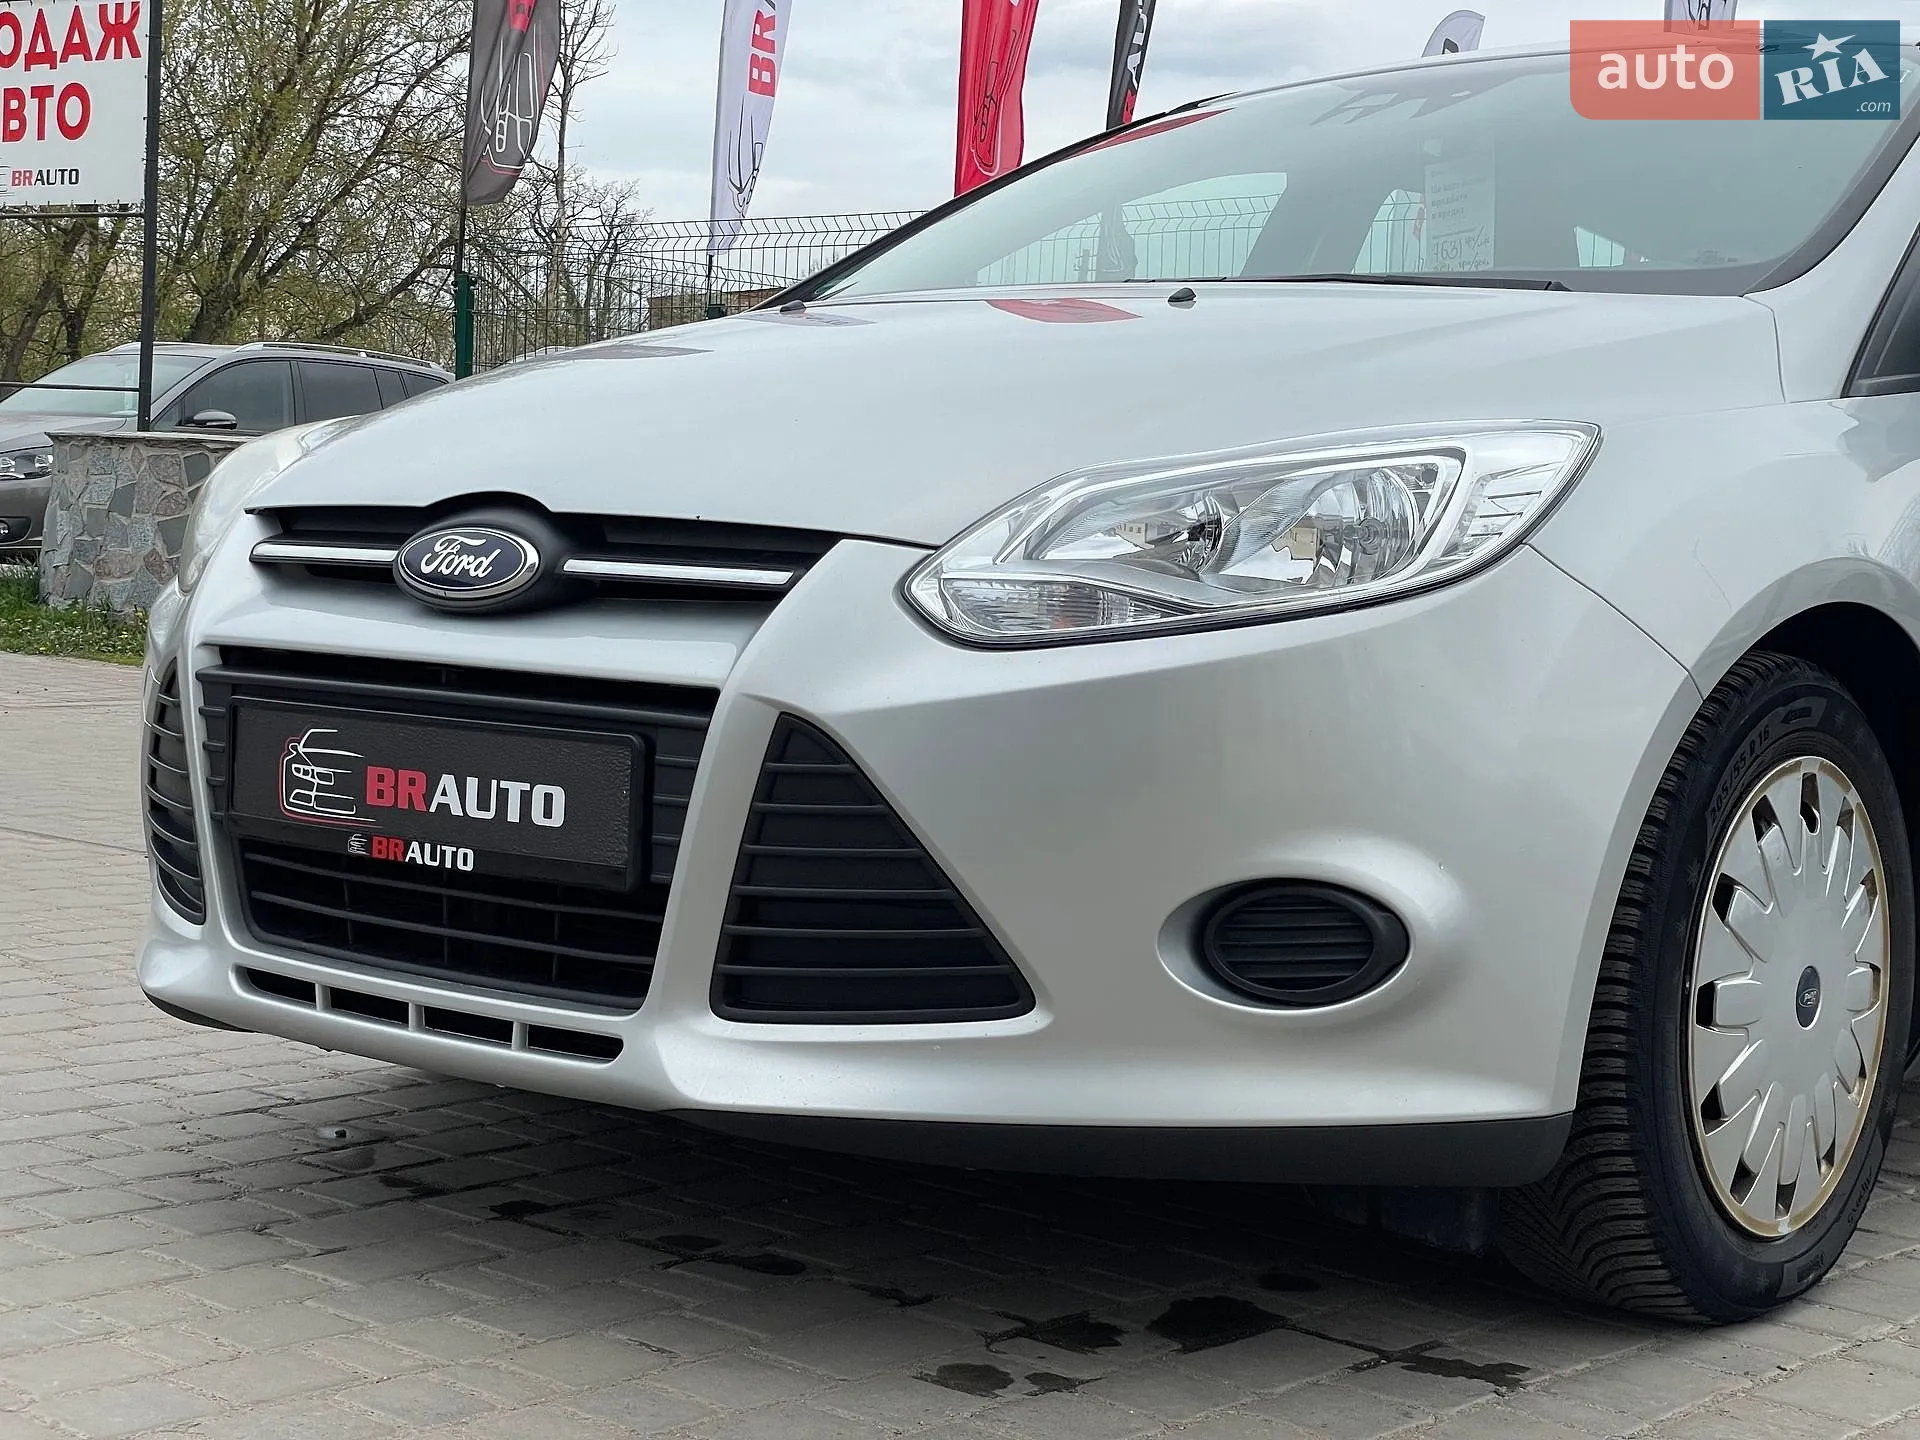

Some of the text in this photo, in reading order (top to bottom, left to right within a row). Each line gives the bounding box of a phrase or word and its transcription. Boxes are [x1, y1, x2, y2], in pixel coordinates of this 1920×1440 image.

[0, 1, 142, 72] ОДАЖ
[748, 0, 777, 98] BR
[0, 82, 92, 143] ВТО
[11, 168, 80, 187] BRAUTO
[420, 535, 502, 578] Ford
[366, 765, 566, 828] BRAUTO
[371, 836, 475, 872] BRAUTO
